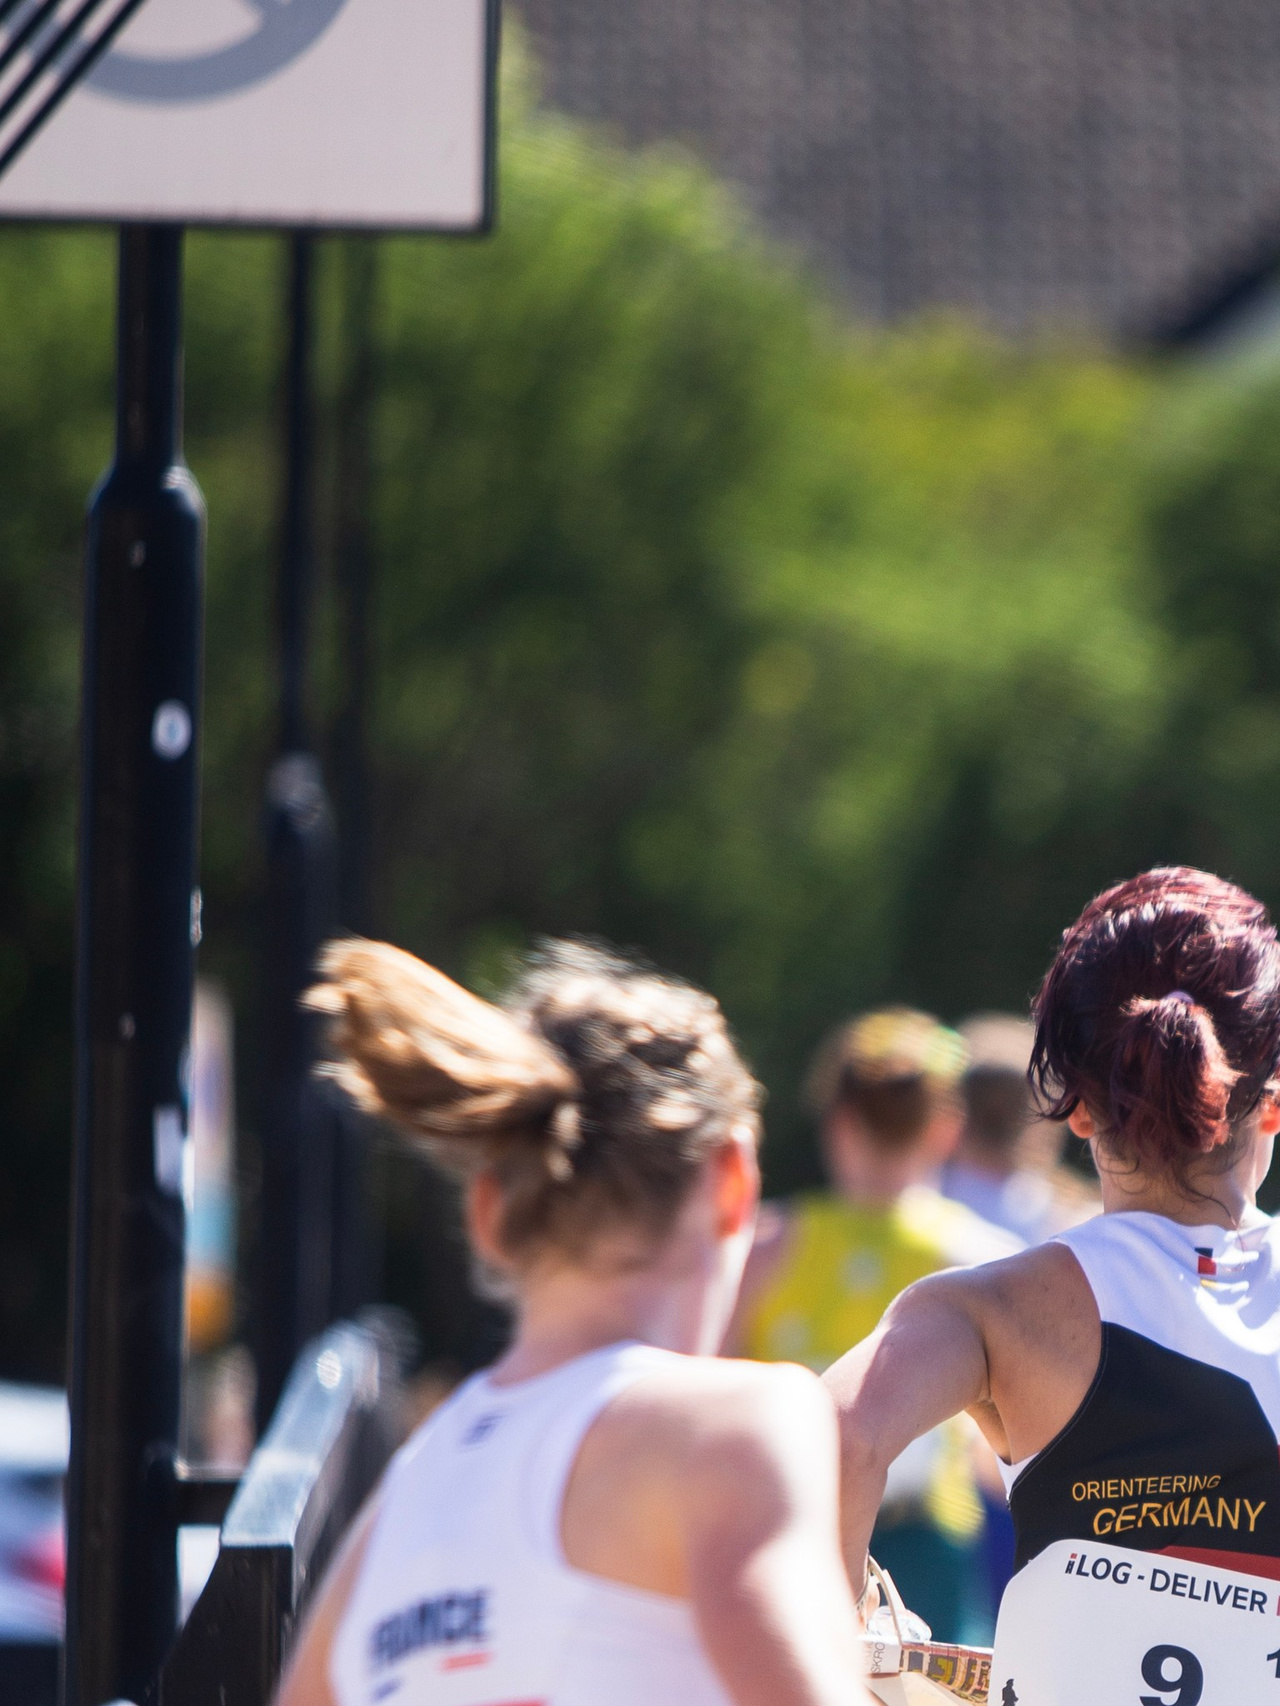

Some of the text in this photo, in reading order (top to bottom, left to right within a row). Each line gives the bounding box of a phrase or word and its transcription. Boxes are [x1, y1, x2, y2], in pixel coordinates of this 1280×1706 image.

[1072, 1475, 1222, 1502] ORIENTEERING
[1093, 1497, 1266, 1535] GERMANY
[1149, 1568, 1268, 1614] DELIVER
